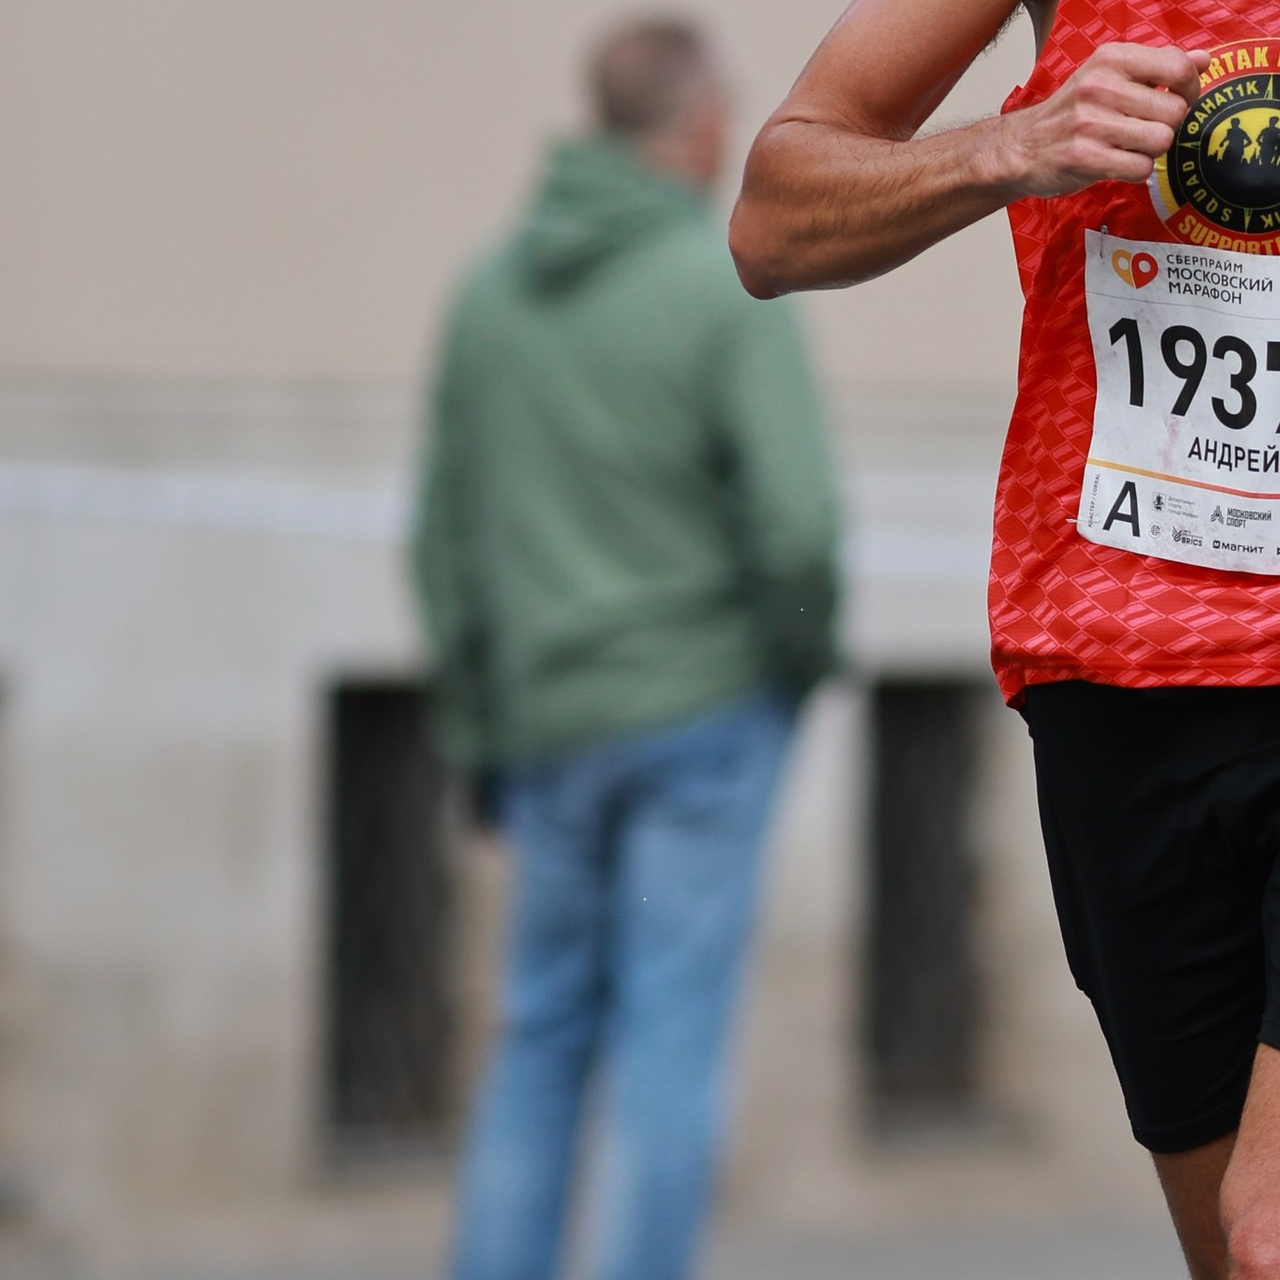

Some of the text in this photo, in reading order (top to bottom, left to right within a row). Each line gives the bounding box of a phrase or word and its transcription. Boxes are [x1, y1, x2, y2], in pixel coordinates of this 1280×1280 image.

[1199, 46, 1269, 89] RTAK
[1182, 161, 1232, 222] SQUAD
[1166, 254, 1243, 273] СБЕРПРАЙМ
[1167, 267, 1273, 292] МОСКОВСКИЙ
[1168, 282, 1242, 304] МАРАФОН
[1187, 436, 1280, 473] АНДРЕЙ
[1226, 519, 1246, 529] СПОРТ
[1227, 507, 1272, 522] МОСКОВСКИЙ
[1181, 536, 1203, 547] BRICS
[1221, 541, 1264, 554] магнит
